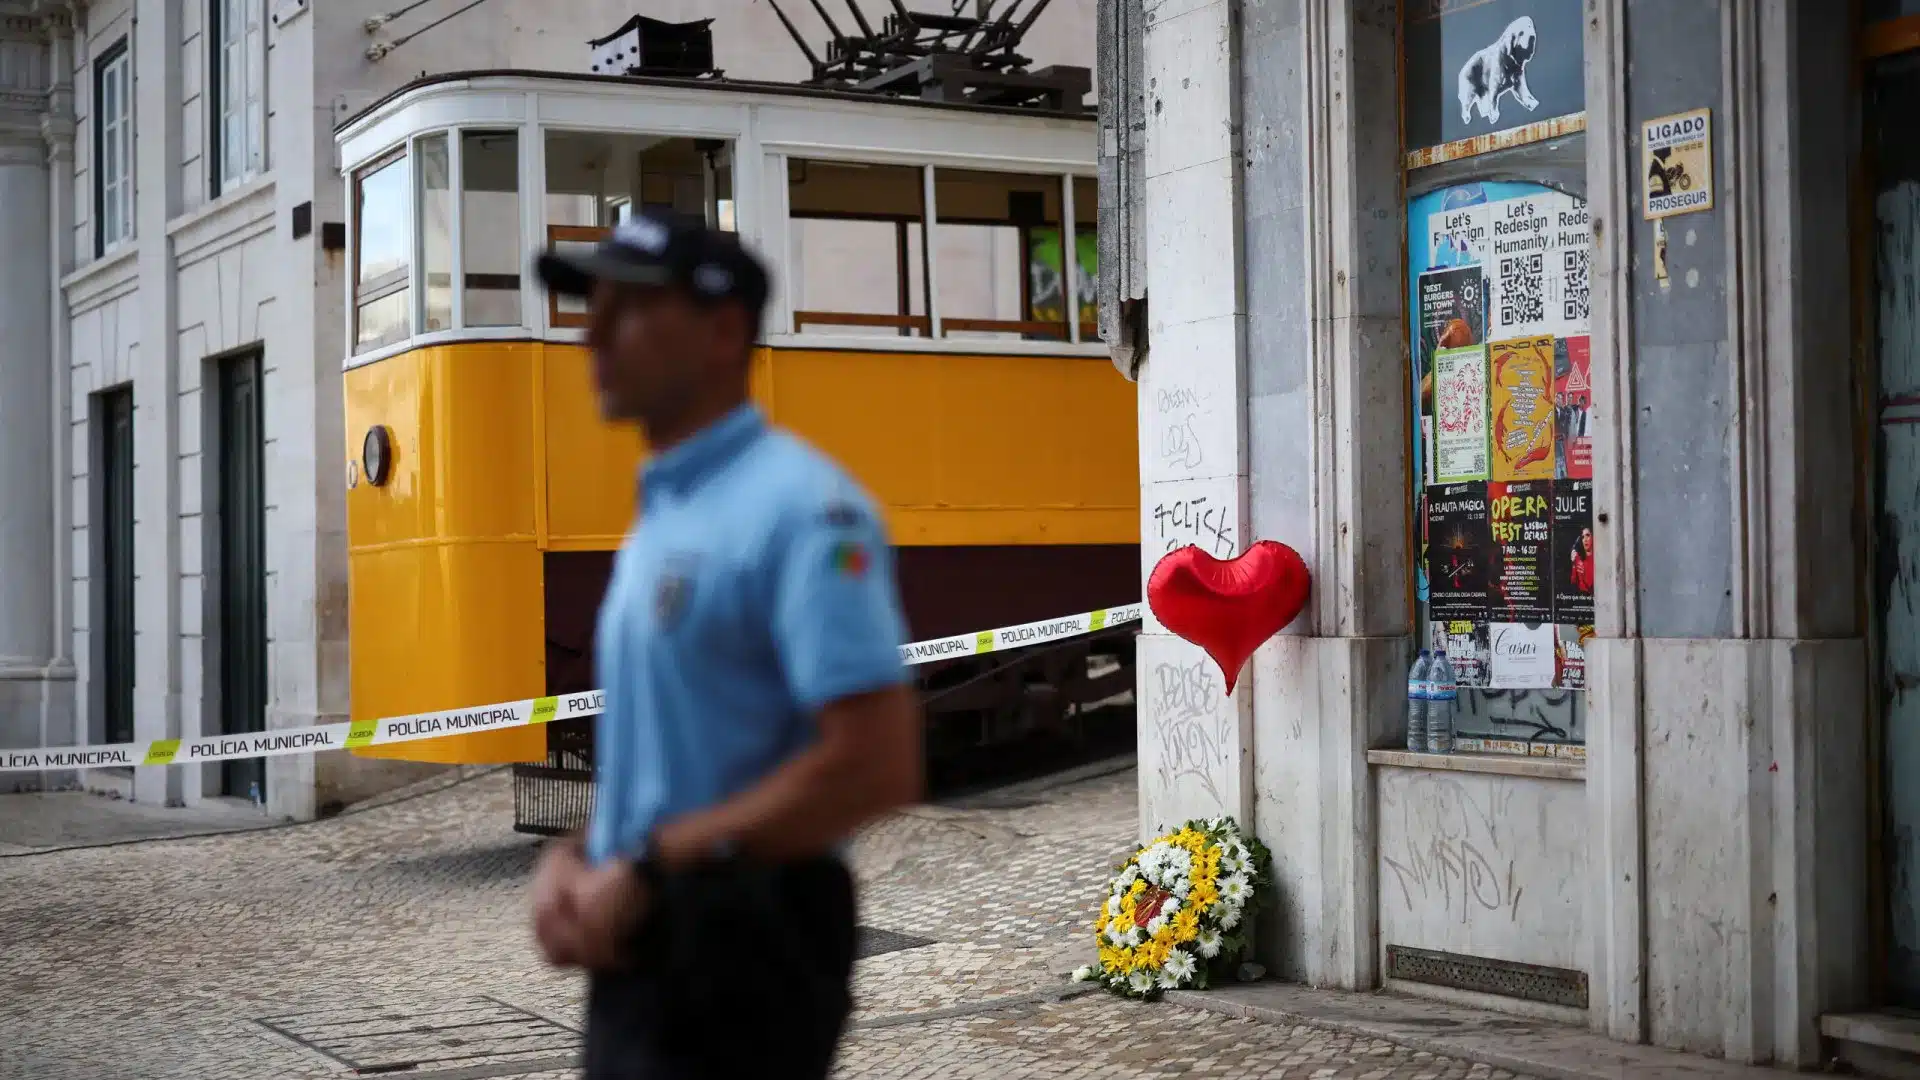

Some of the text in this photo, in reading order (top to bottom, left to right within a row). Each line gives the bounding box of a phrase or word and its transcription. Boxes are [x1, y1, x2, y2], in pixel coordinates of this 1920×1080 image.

[1648, 117, 1704, 141] LIGADO
[1507, 201, 1534, 219] Let's
[1649, 191, 1708, 211] PROSEGUR
[1445, 212, 1471, 230] Let's
[1494, 216, 1547, 236] Redesign
[1494, 235, 1548, 255] Humanity
[1424, 291, 1454, 302] BURGERS
[1424, 302, 1432, 310] IN
[1429, 499, 1485, 513] A FLAUTA MÁGICA
[1492, 495, 1548, 519] OPERA
[1555, 496, 1587, 512] JULIE
[1491, 521, 1522, 542] FEST
[1524, 522, 1548, 531] LISBOA
[1524, 531, 1548, 541] OEIRAS
[1521, 546, 1527, 554] 16
[1528, 546, 1537, 554] SET
[916, 640, 969, 657] MUNICIPAL
[1001, 628, 1037, 644] POLÍCIA
[1037, 619, 1082, 638] MUNICIPAL
[1111, 608, 1141, 624] POLÍCIA
[45, 750, 132, 768] MUNICIPAL
[190, 741, 249, 758] POLÍCIA
[254, 731, 334, 753] MUNICIPAL
[348, 729, 374, 739] LISBOA
[388, 718, 442, 737] POLÍCIA
[446, 707, 520, 731] MUNICIPAL
